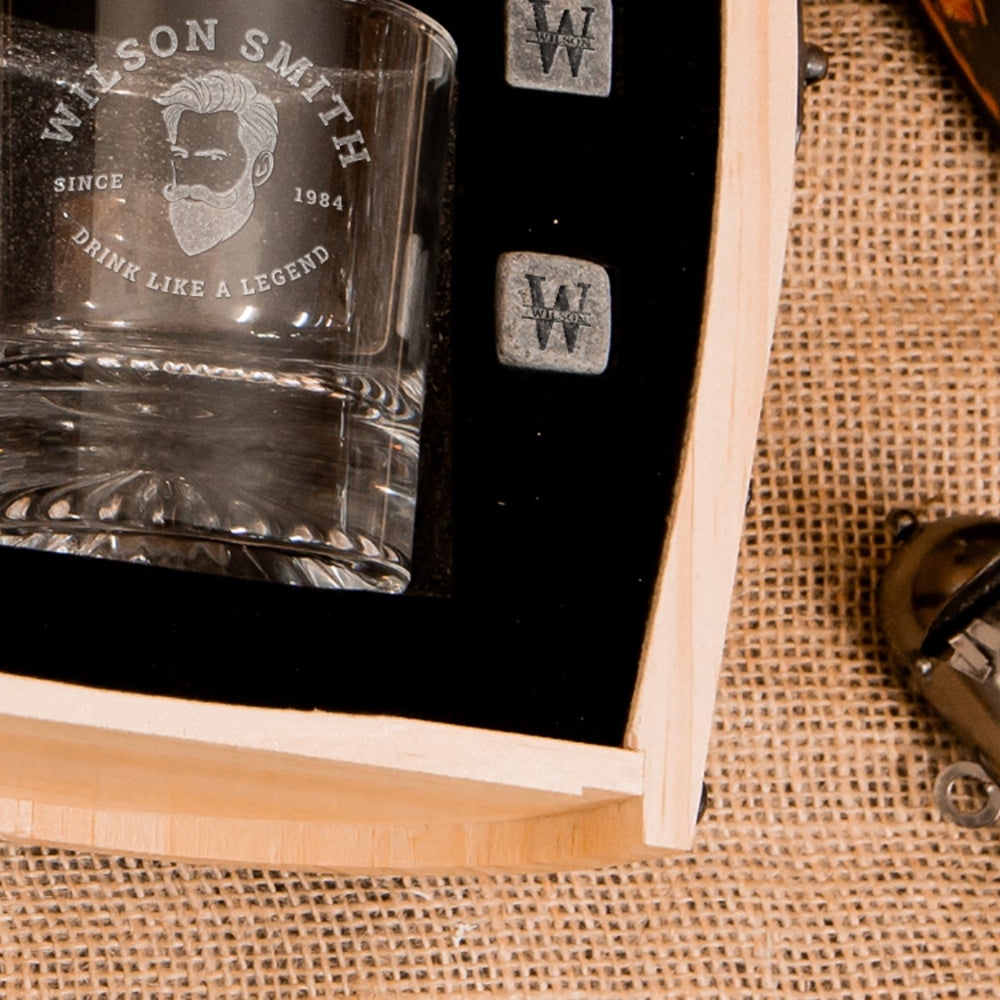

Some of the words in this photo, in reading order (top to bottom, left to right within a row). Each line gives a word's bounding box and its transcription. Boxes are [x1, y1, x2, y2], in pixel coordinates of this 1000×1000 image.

[40, 18, 218, 145] WILSON
[239, 28, 371, 169] SMITH
[53, 173, 124, 193] SINCE
[293, 187, 344, 211] 1984
[71, 227, 141, 283] DRINK
[146, 272, 205, 298] LIKE
[215, 280, 232, 299] A
[240, 244, 331, 296] LEGEND
[524, 273, 592, 354] W
